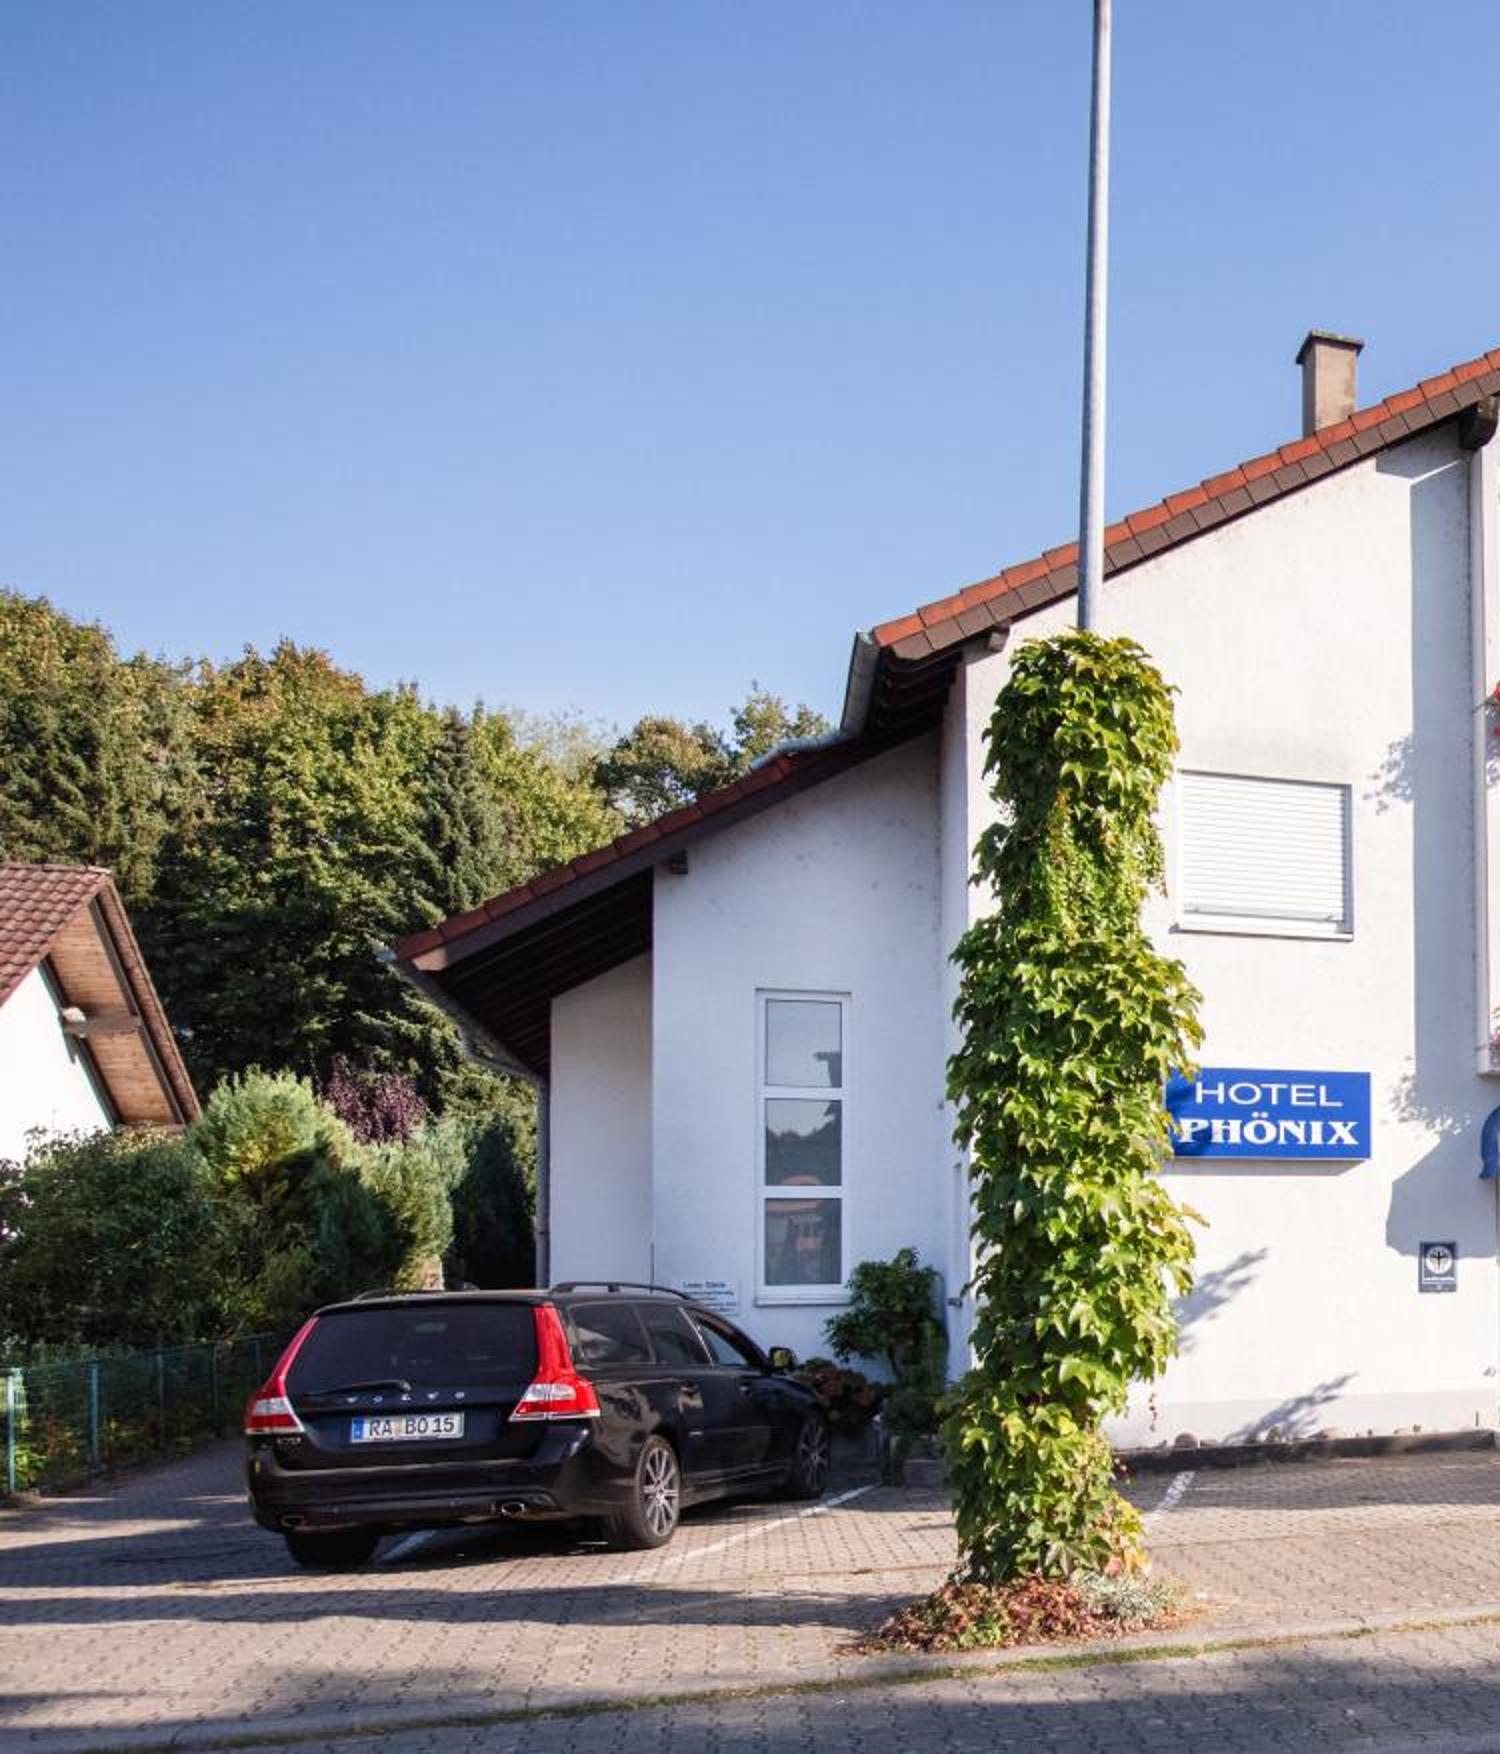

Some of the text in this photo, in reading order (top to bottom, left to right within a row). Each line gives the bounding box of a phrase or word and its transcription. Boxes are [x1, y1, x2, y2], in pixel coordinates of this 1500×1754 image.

[1195, 1082, 1343, 1107] HOTEL
[1178, 1111, 1360, 1146] PHÖNIX
[369, 1419, 392, 1436] RA
[434, 1416, 454, 1433] 15
